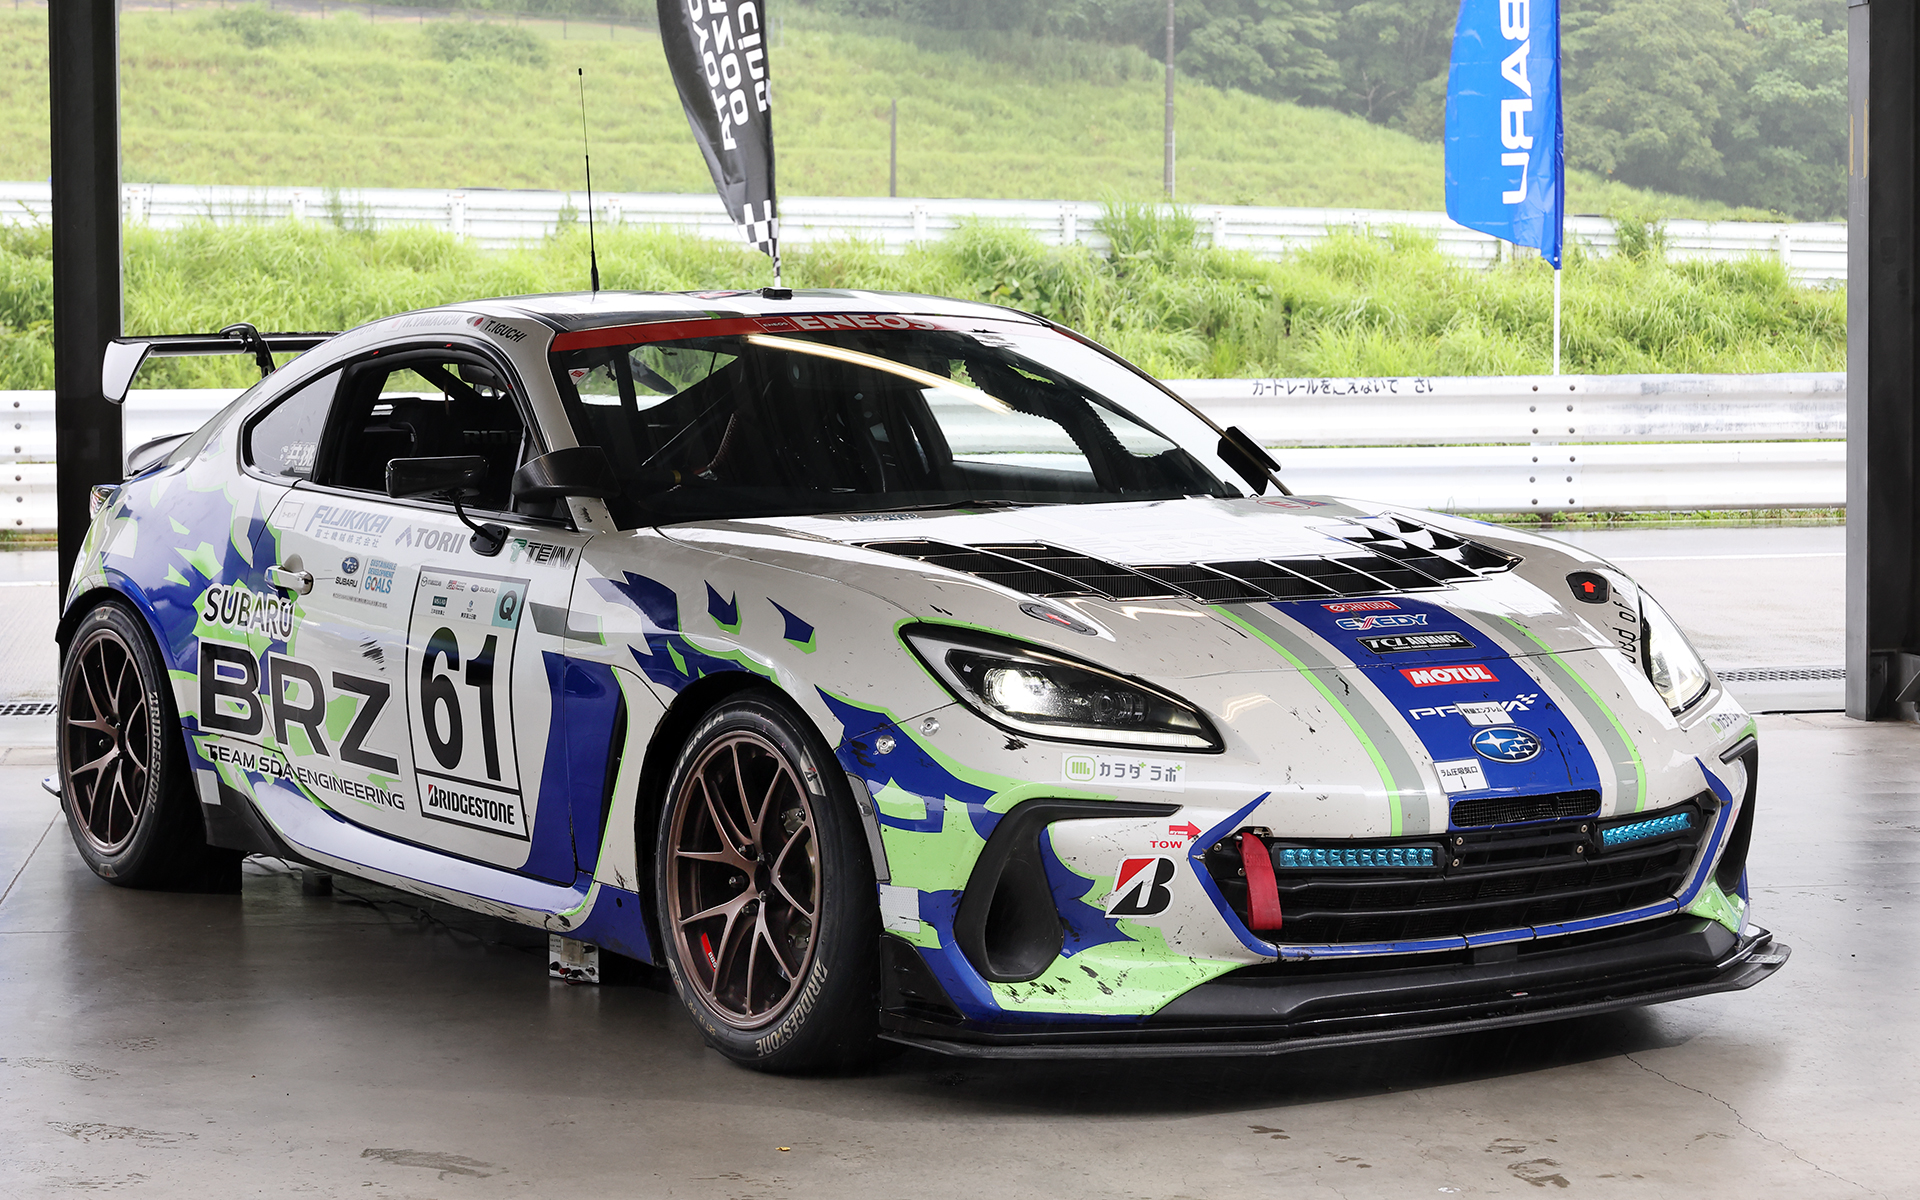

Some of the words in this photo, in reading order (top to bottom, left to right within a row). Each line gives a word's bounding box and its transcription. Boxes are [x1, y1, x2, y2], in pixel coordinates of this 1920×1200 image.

[484, 319, 528, 343] T.IGUCHI
[789, 314, 935, 330] ENEOS
[305, 505, 393, 533] FUJIKIKAI
[415, 527, 466, 554] TORII
[526, 541, 574, 569] TEIN
[335, 577, 358, 588] SUBARU
[365, 577, 392, 594] GOALS
[204, 588, 293, 639] SUBARU
[499, 590, 518, 621] Q
[1336, 614, 1428, 630] EXEDY
[1366, 638, 1408, 649] TCL
[1406, 634, 1464, 646] ADVANCE
[1409, 666, 1492, 685] MOTUL
[200, 642, 399, 775] BRZ
[420, 627, 501, 781] 61
[147, 690, 162, 814] BRIDGESTONE
[204, 743, 255, 770] TEAM
[258, 757, 293, 780] SDA
[296, 765, 405, 811] ENGINEERING
[428, 784, 515, 826] BRIDGESTONE
[1150, 840, 1182, 849] TOW
[756, 956, 829, 1058] BRIDGESTONE
